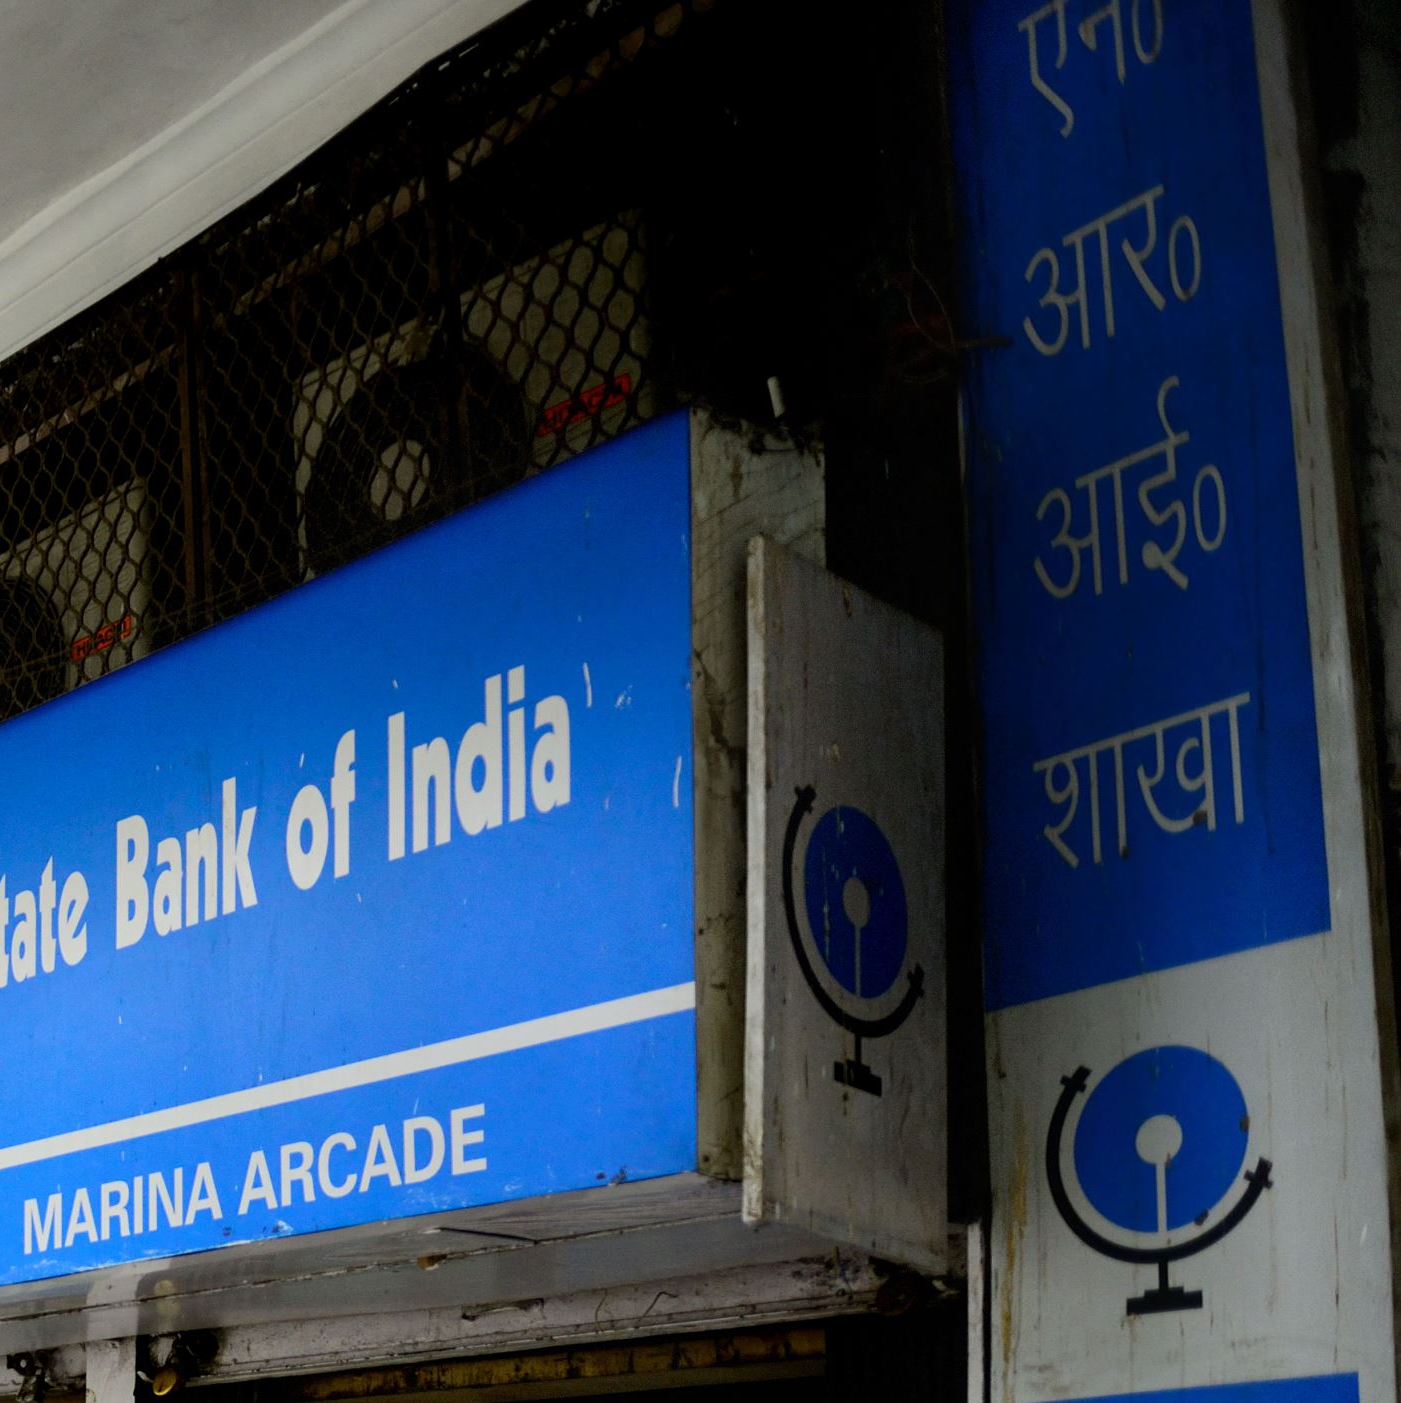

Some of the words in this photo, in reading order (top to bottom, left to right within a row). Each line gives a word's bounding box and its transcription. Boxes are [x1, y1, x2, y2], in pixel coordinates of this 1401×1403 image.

[116, 777, 258, 949] Bank
[286, 729, 356, 891] of
[388, 664, 571, 861] India
[1033, 693, 1250, 868] शाखा
[23, 1162, 223, 1255] MARINA
[238, 1103, 488, 1215] ARCADE
